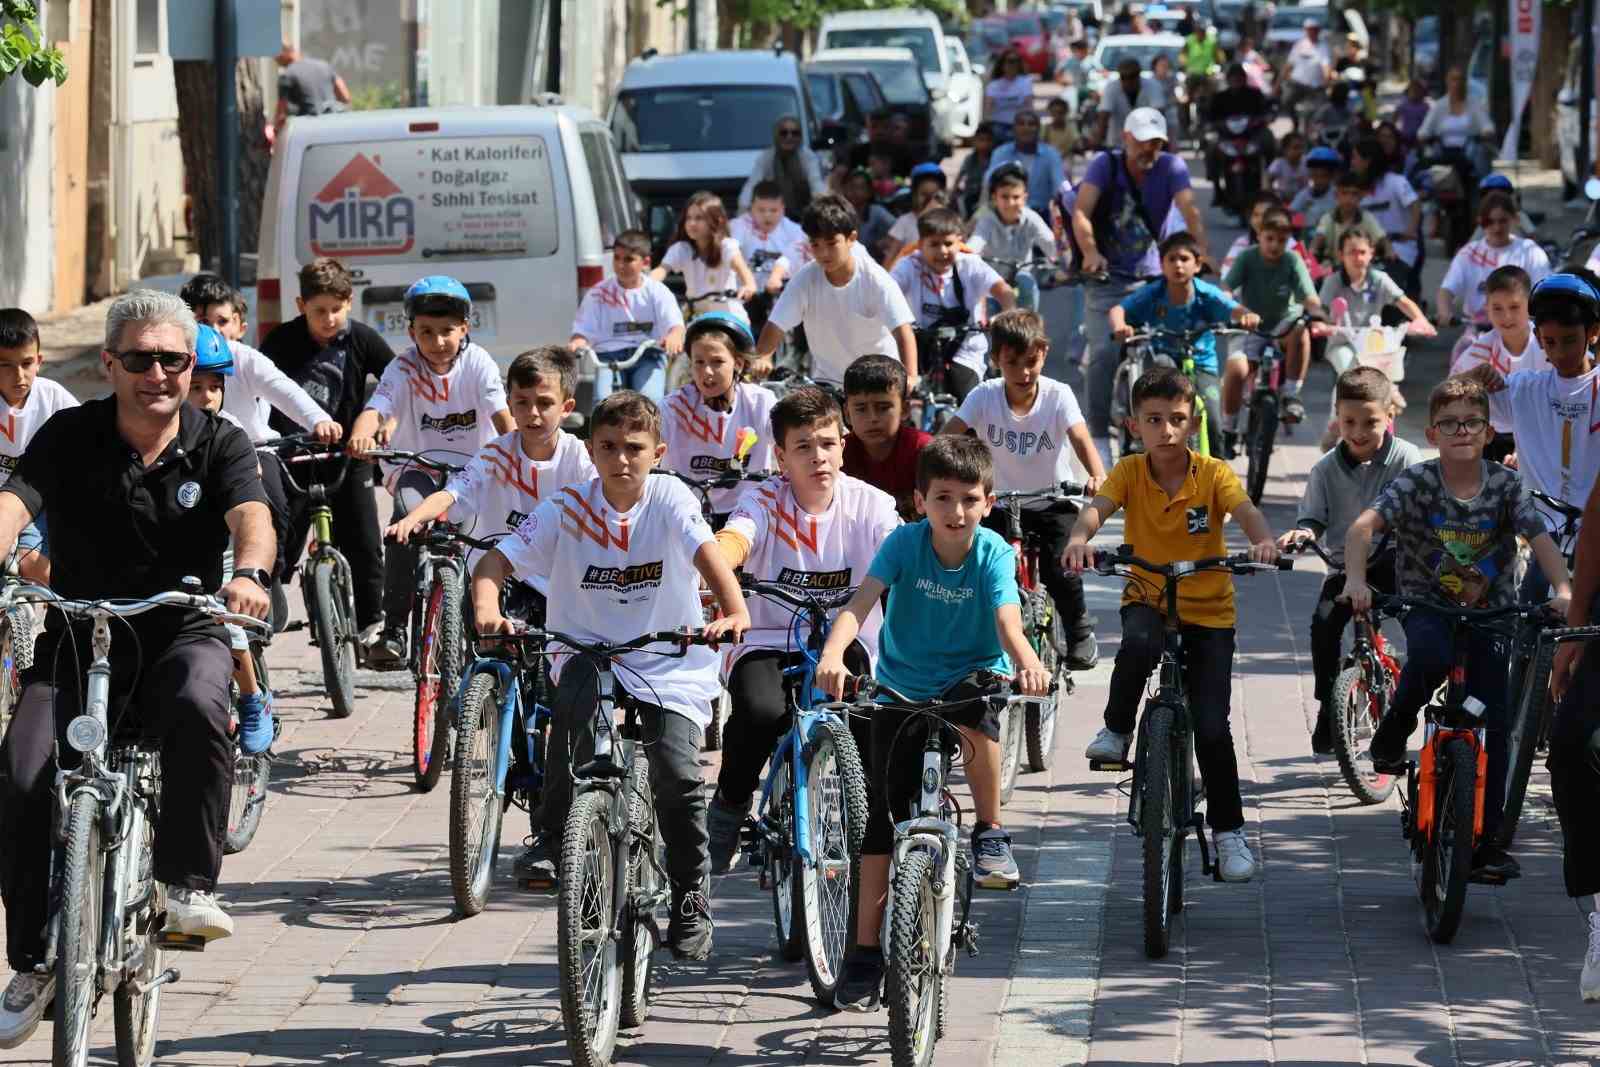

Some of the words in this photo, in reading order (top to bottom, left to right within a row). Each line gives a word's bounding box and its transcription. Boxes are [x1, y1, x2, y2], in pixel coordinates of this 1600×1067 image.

[431, 147, 459, 161] Kat
[465, 145, 543, 161] Kaloriferi
[431, 169, 509, 187] Doğalgaz
[480, 190, 538, 206] Tesisat
[987, 423, 1056, 455] USPA
[782, 569, 849, 587] #BEACTIV
